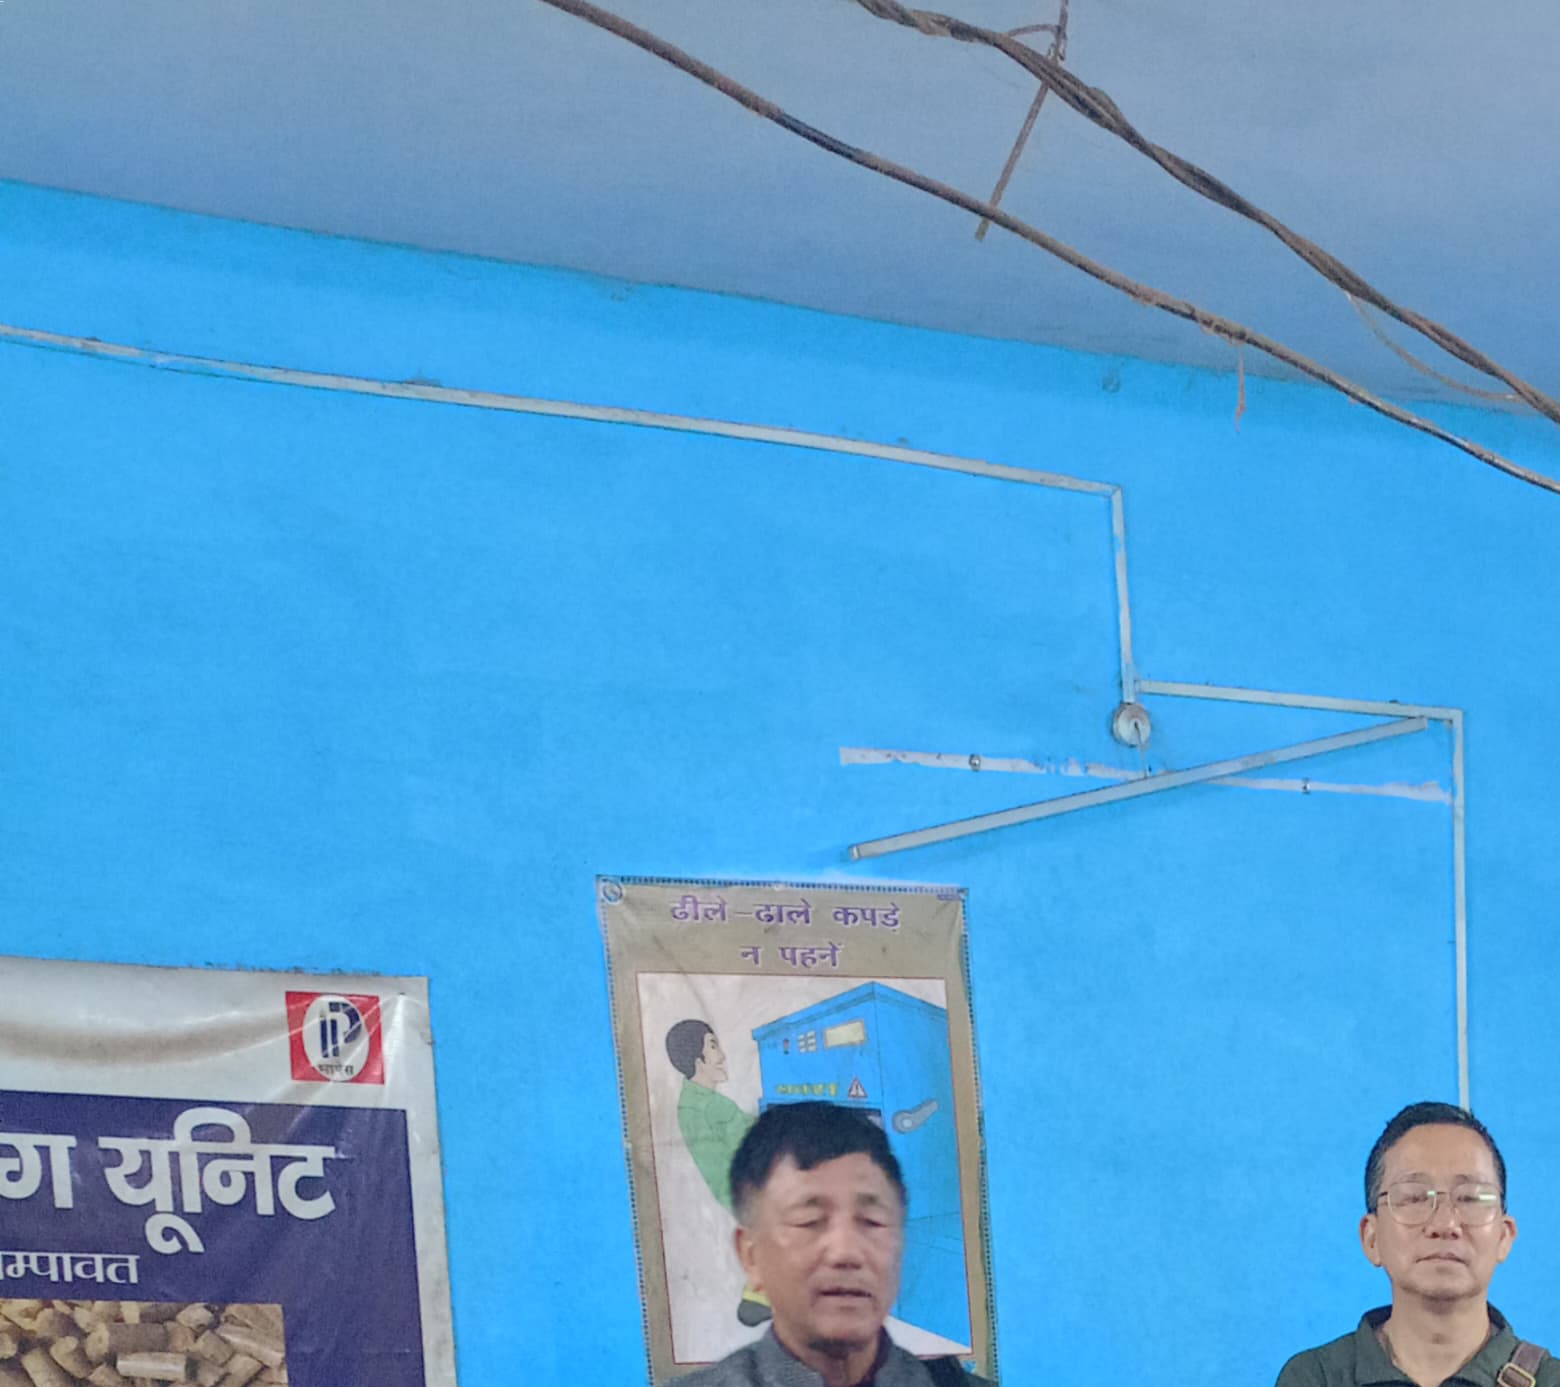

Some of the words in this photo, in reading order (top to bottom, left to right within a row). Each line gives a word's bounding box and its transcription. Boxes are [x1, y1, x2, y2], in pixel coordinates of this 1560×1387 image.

[832, 902, 900, 932] कपड़े
[740, 945, 761, 966] न
[98, 1106, 336, 1254] यूनिट
[0, 1251, 140, 1284] म्पावत
